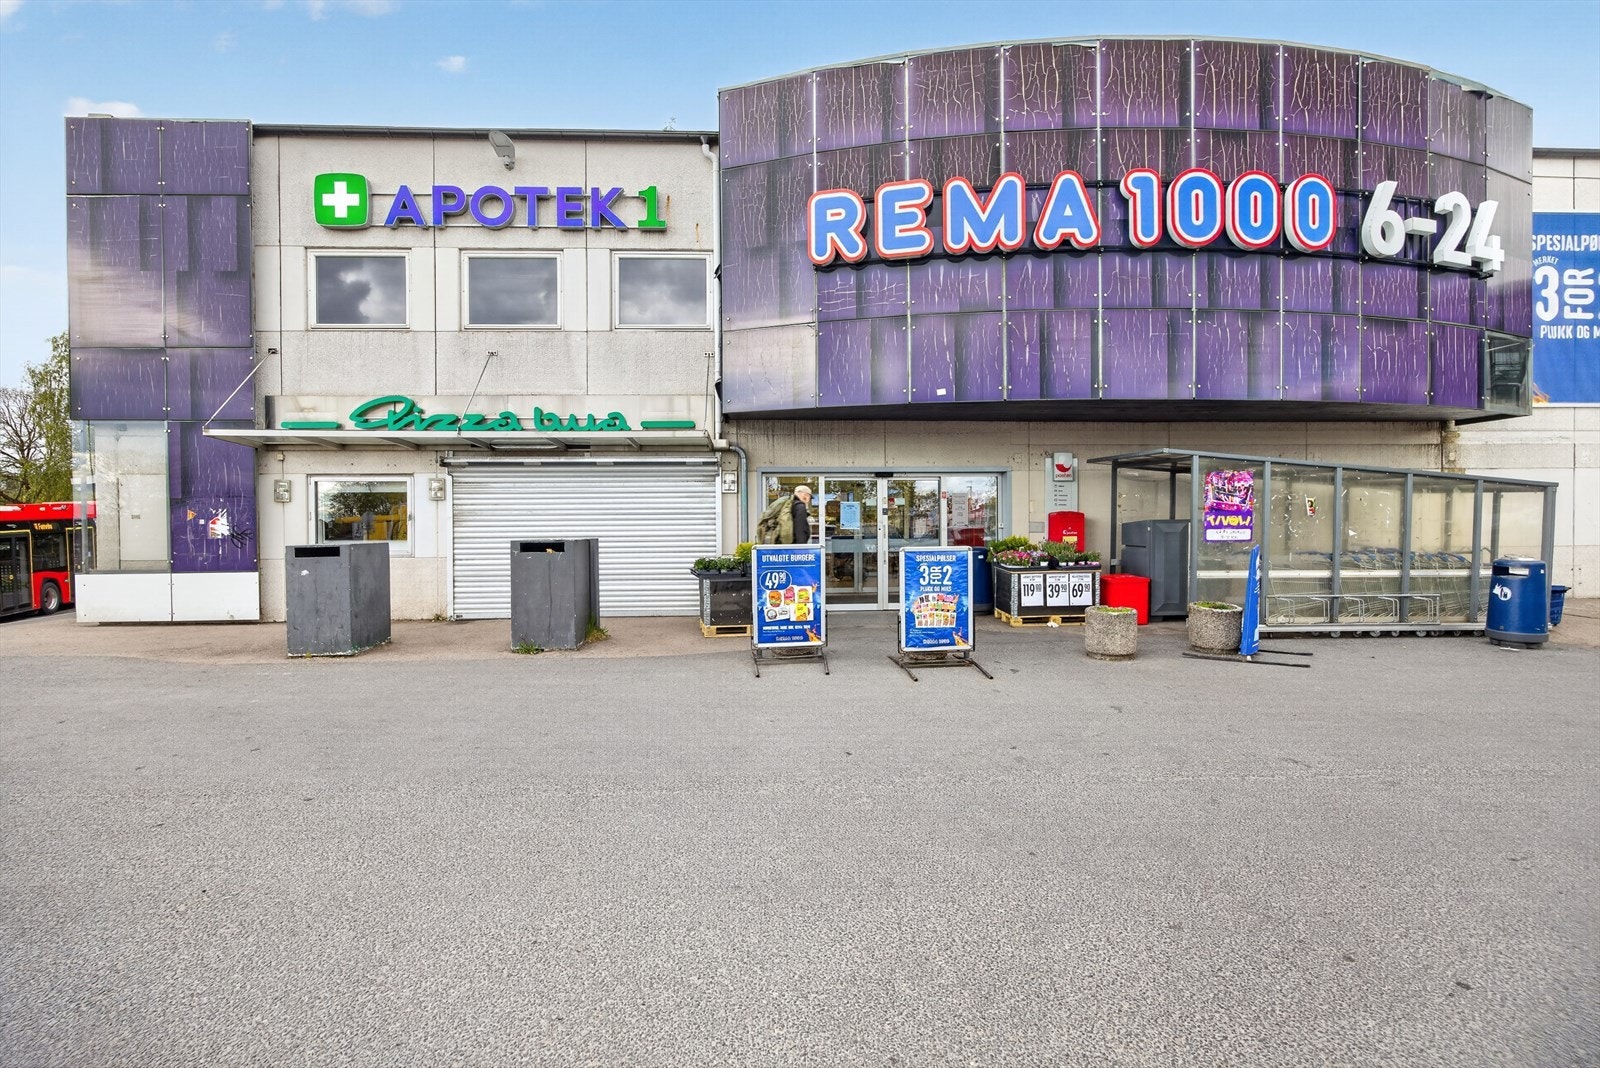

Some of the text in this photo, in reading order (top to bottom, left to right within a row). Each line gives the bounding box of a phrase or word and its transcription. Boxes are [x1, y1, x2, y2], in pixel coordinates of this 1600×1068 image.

[384, 184, 668, 232] APOTEK 1
[807, 168, 1338, 266] REMA 1000
[1361, 180, 1505, 273] 6-24
[1532, 234, 1600, 251] SPESIALPØ
[1533, 255, 1559, 267] MERKET
[1534, 265, 1560, 322] 3
[1563, 268, 1595, 320] FOR
[1540, 325, 1573, 339] PLUKK
[1576, 325, 1590, 339] OG
[348, 394, 632, 432] Pizza bua
[761, 553, 816, 563] UTVALGTE BURGERE
[919, 565, 930, 586] 3
[930, 566, 942, 585] FOR
[942, 565, 953, 585] 2
[1048, 583, 1060, 598] 39
[1071, 583, 1084, 598] 69
